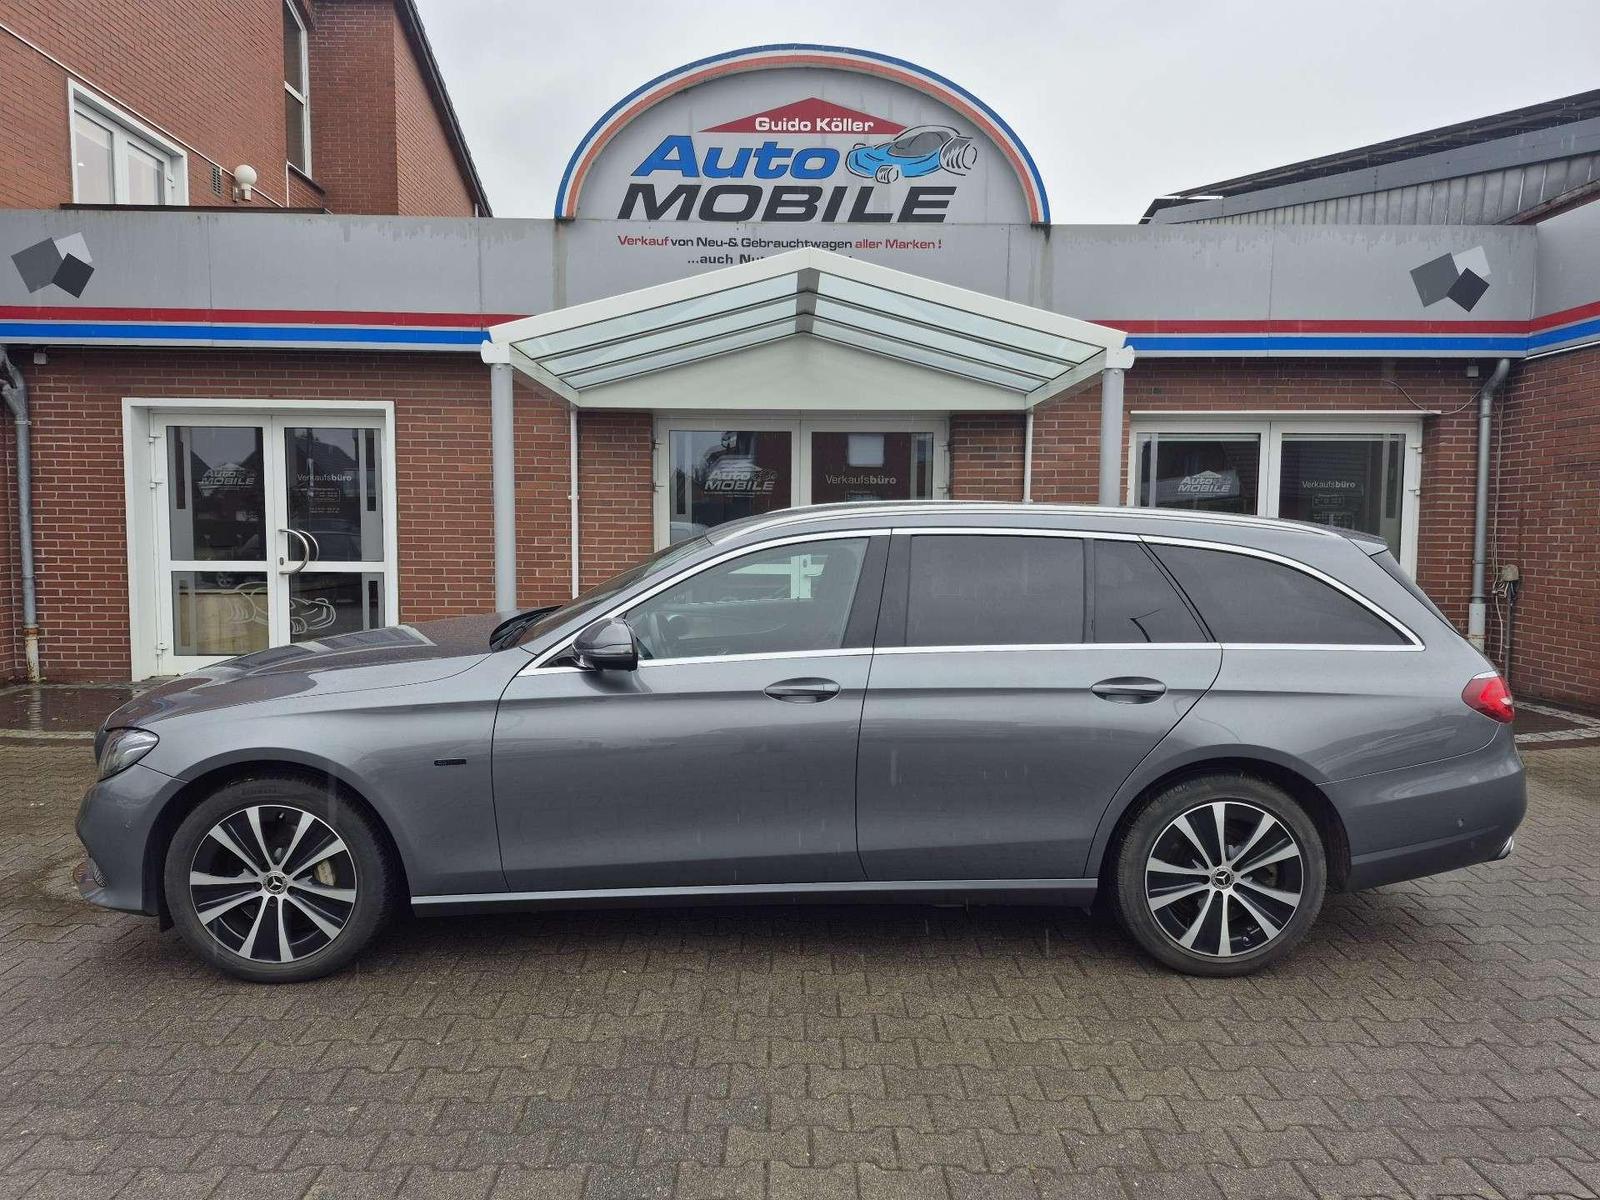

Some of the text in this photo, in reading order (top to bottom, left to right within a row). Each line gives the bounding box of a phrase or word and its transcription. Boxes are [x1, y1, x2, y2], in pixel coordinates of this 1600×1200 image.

[755, 117, 874, 132] Guido Köller
[630, 135, 840, 180] Auto
[617, 184, 957, 223] MOBILE
[618, 236, 669, 246] Verkauf
[671, 239, 694, 247] von
[741, 238, 852, 251] Gebrauchtwagen
[855, 239, 882, 248] aller
[704, 480, 776, 491] MOBILE
[825, 474, 897, 485] Verkaufsbüro
[1180, 476, 1213, 485] Auto
